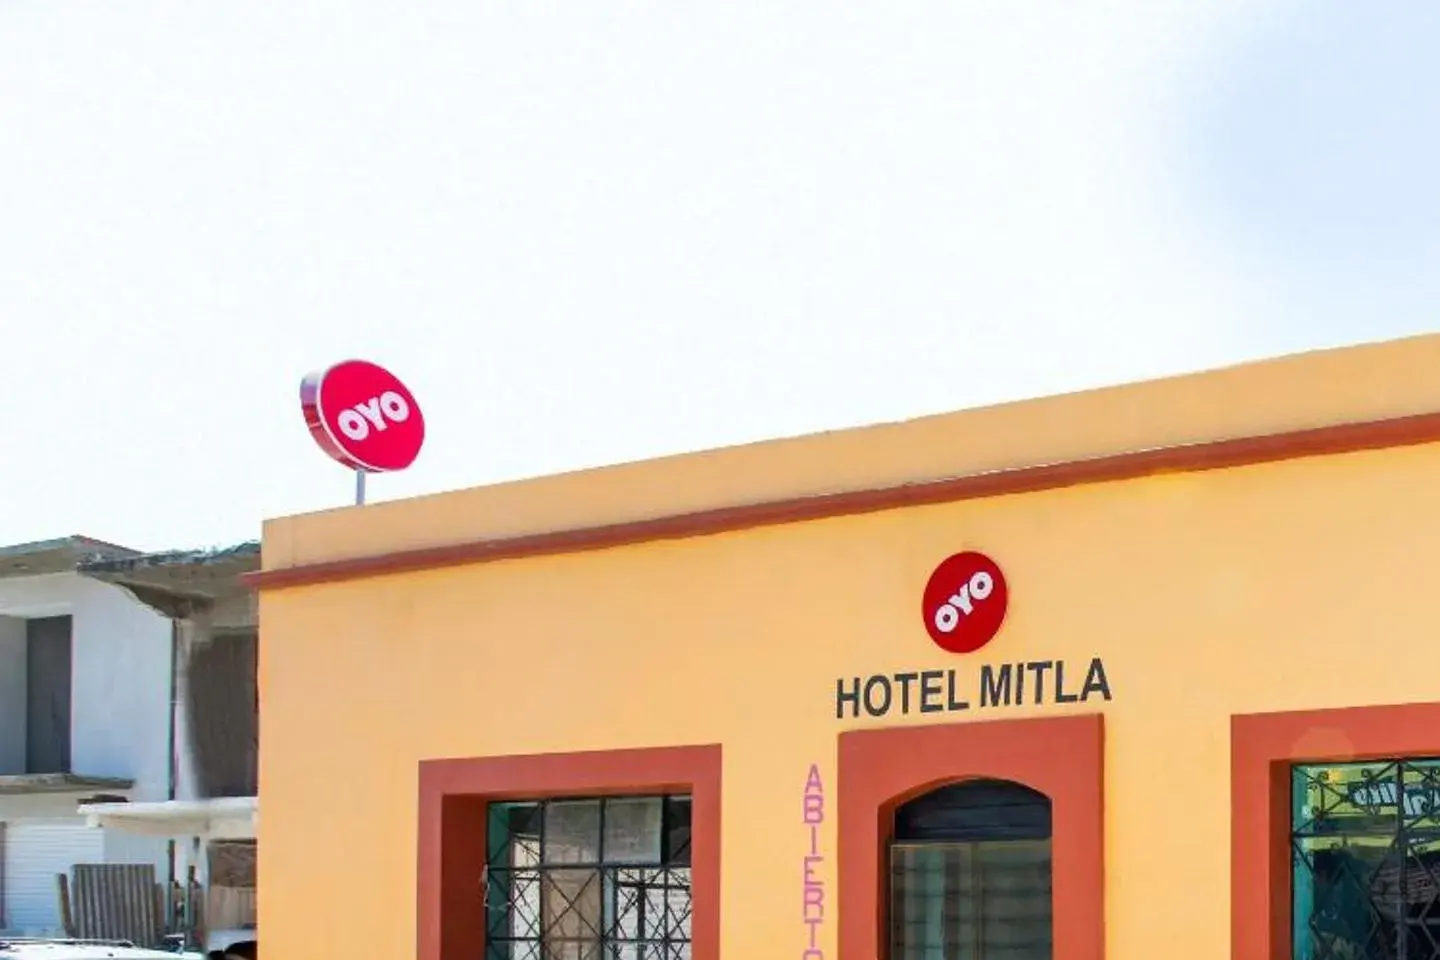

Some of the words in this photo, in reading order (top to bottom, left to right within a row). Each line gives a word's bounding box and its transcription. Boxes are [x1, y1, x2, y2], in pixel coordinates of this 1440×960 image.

[337, 390, 410, 441] OYO
[934, 571, 994, 633] OYO
[836, 669, 970, 719] HOTEL
[980, 657, 1112, 708] MITLA
